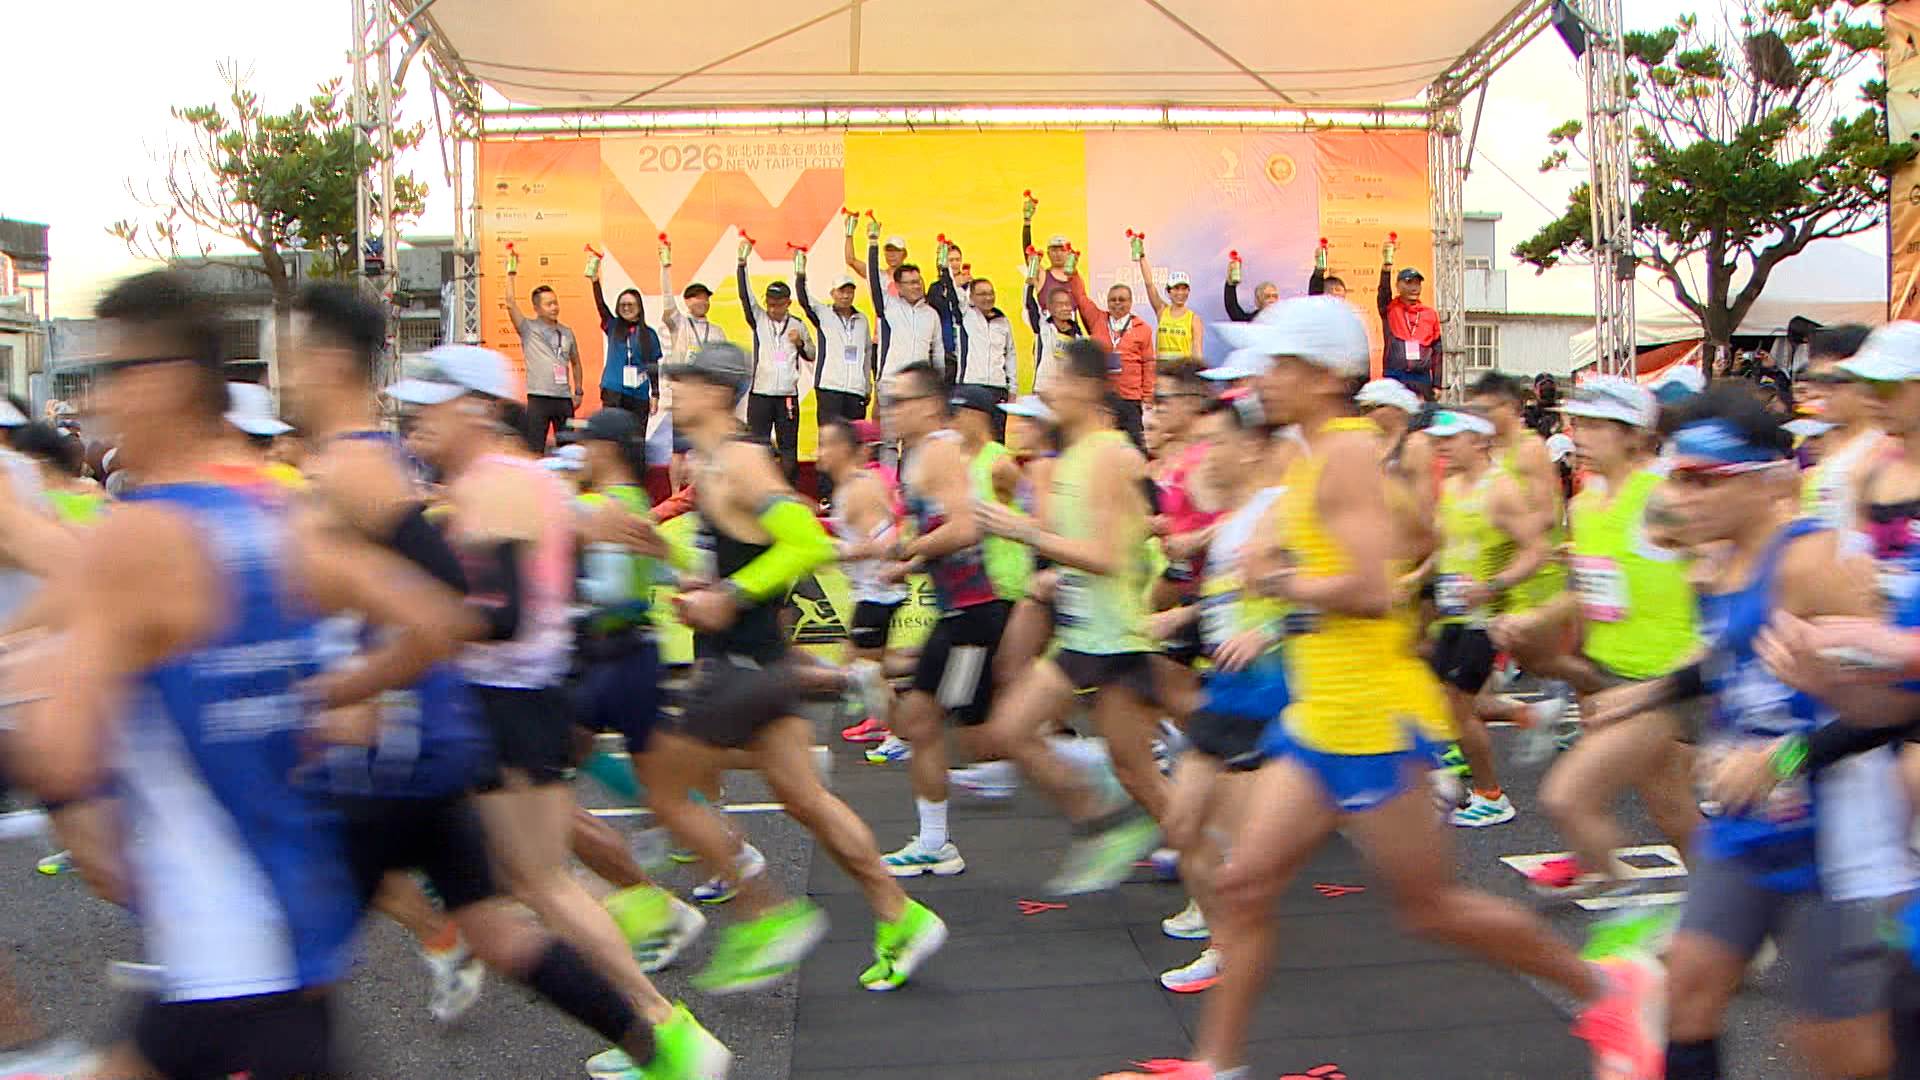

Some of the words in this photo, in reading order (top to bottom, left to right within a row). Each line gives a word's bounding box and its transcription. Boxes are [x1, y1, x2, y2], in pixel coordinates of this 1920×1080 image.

[639, 144, 723, 172] 2026
[726, 158, 759, 170] NEW
[766, 157, 807, 170] TAIPEI
[811, 157, 843, 169] CITY
